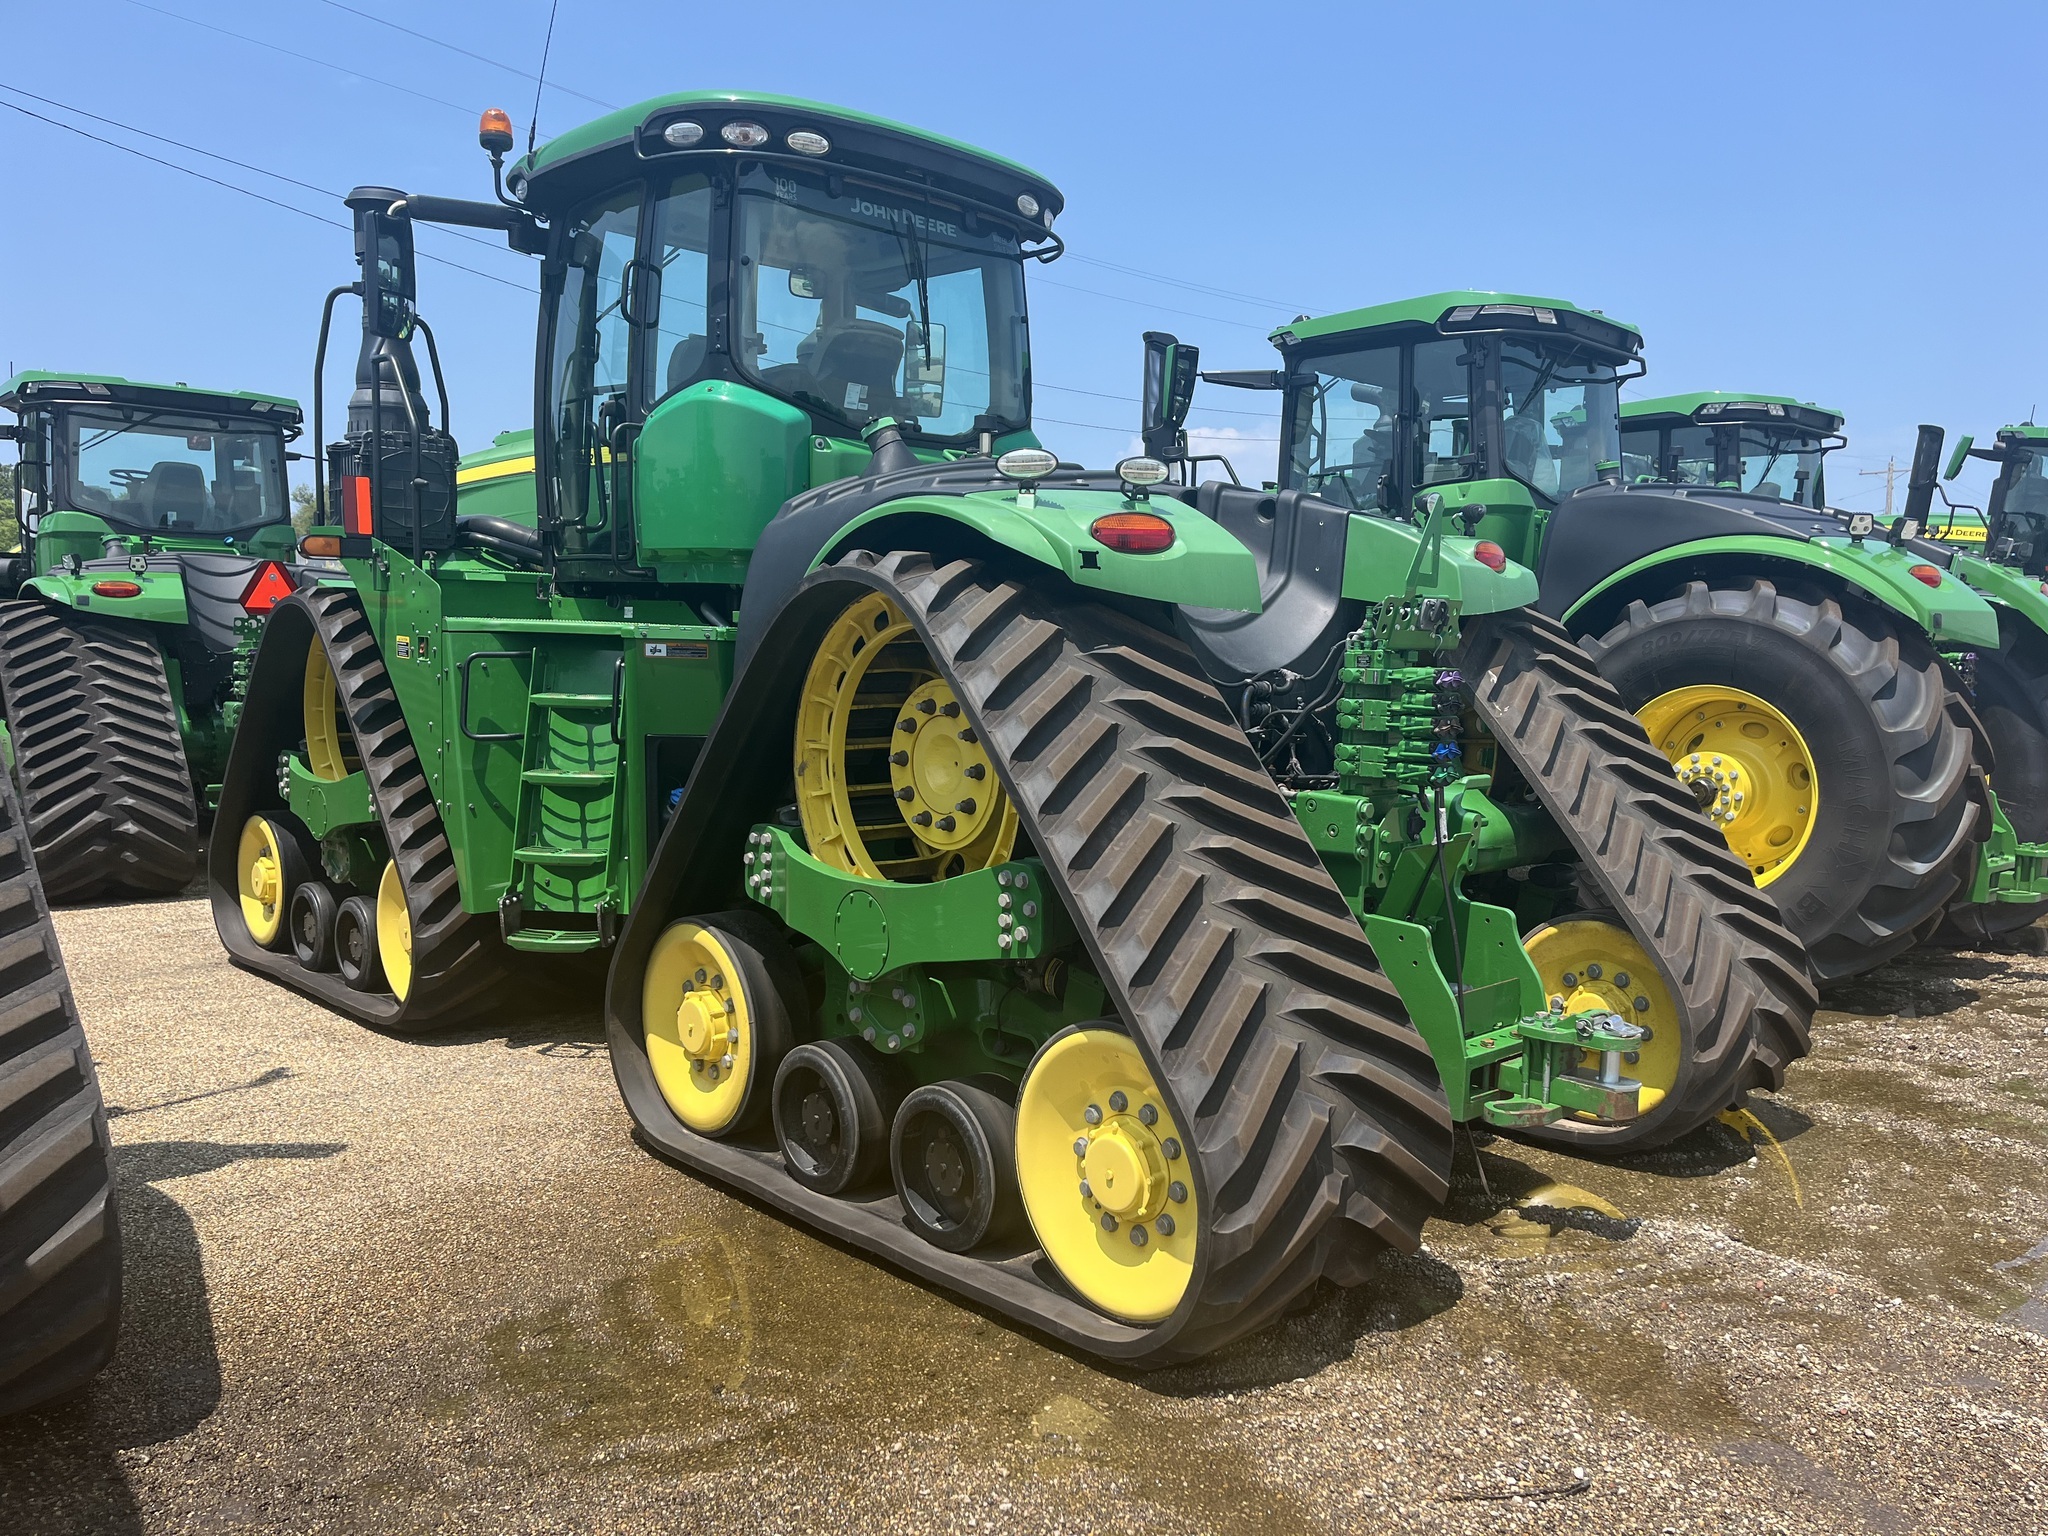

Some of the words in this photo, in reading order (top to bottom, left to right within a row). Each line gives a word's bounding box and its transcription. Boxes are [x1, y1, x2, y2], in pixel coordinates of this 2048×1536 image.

[774, 176, 797, 194] 100
[775, 189, 798, 201] YEARS
[850, 197, 899, 223] JOHN
[902, 208, 957, 238] DEERE
[1955, 529, 1987, 538] DEERE
